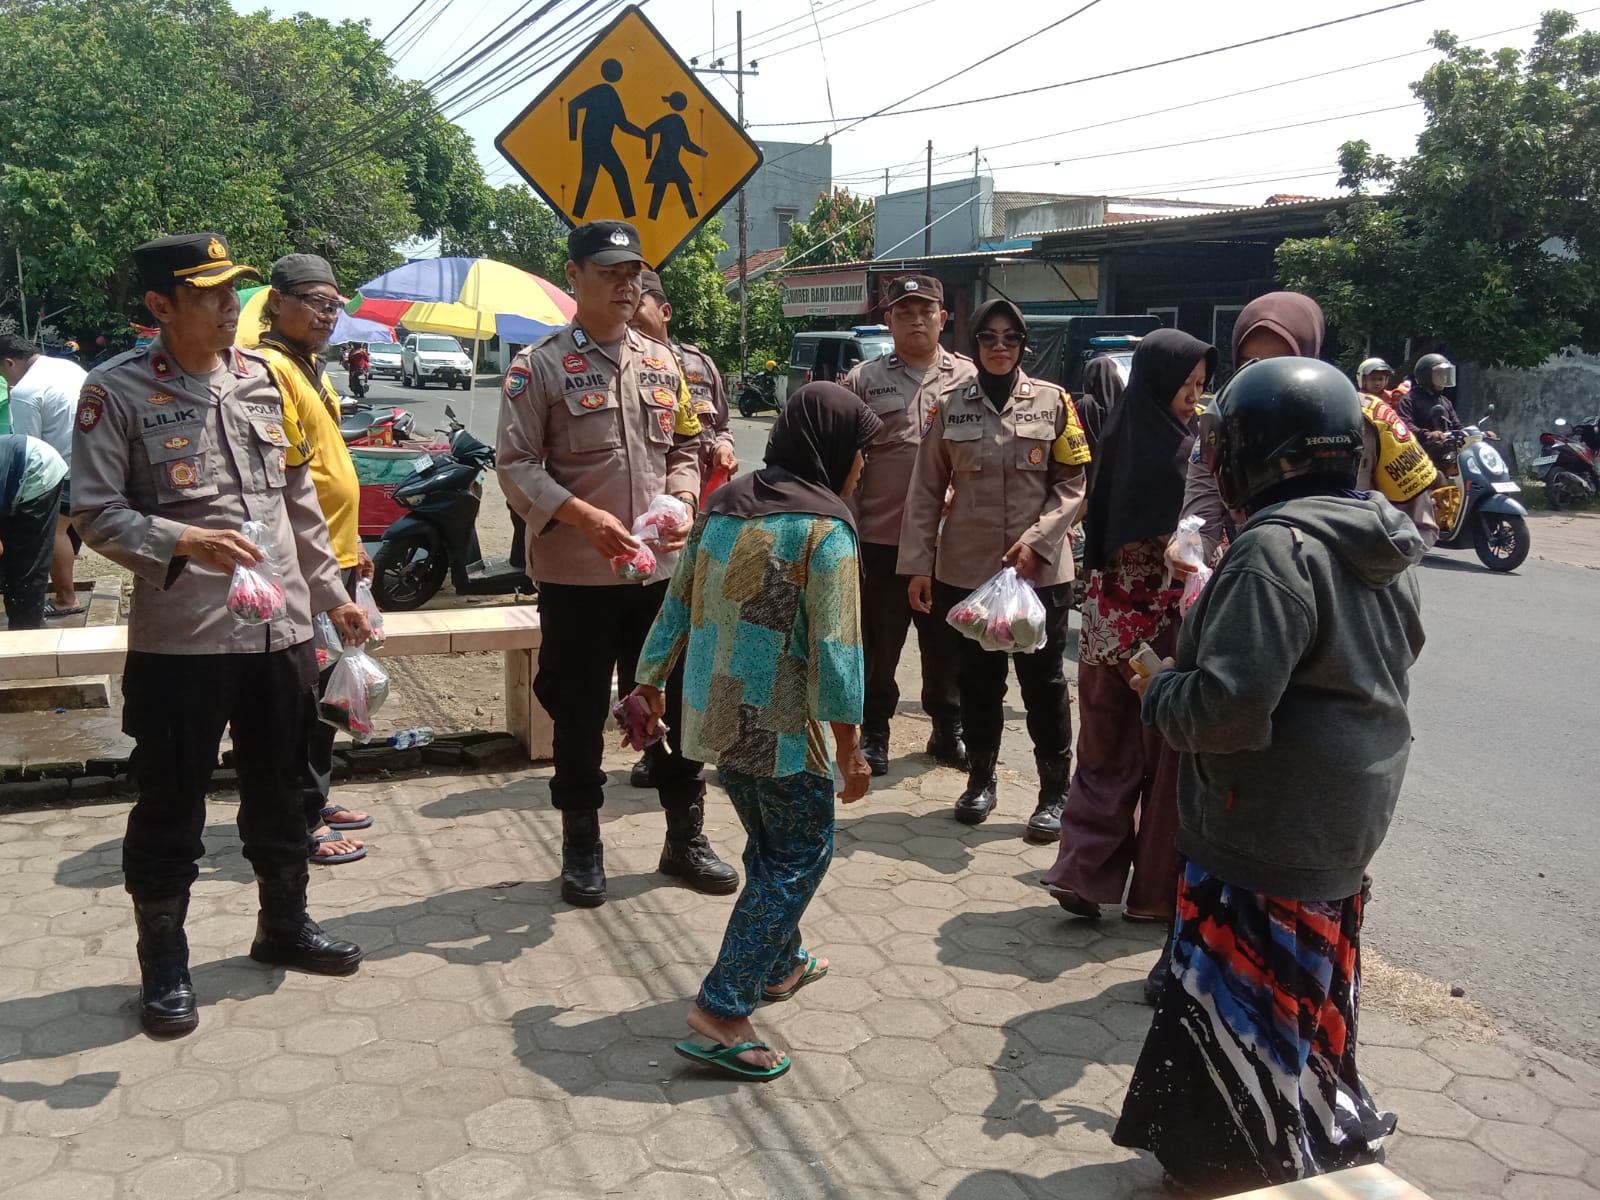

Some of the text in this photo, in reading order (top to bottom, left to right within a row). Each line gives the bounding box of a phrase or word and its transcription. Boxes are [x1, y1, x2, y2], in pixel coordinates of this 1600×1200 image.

[786, 288, 810, 304] SUMBER
[811, 287, 830, 303] BARU
[564, 373, 605, 390] ADJIE
[640, 371, 676, 388] POLRI
[143, 408, 195, 429] LILIK
[948, 413, 983, 424] RIZKY
[1015, 410, 1054, 422] POLRI
[1305, 435, 1352, 446] HONDA
